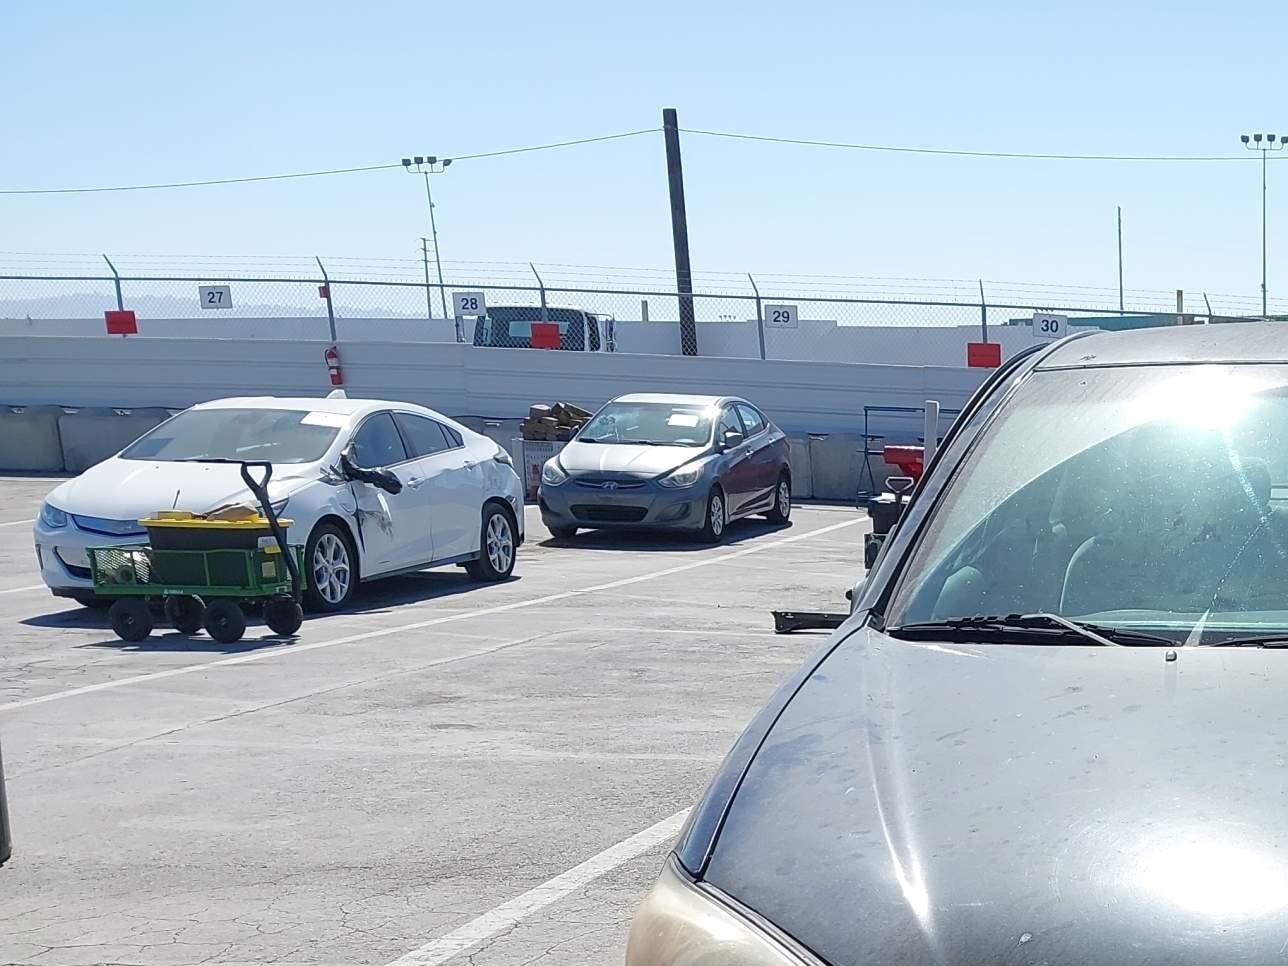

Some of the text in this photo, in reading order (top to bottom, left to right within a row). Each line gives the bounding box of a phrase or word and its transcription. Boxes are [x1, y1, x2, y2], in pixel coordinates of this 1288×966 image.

[207, 291, 224, 304] 27
[460, 297, 478, 310] 28
[772, 310, 790, 323] 29
[1041, 319, 1059, 333] 30
